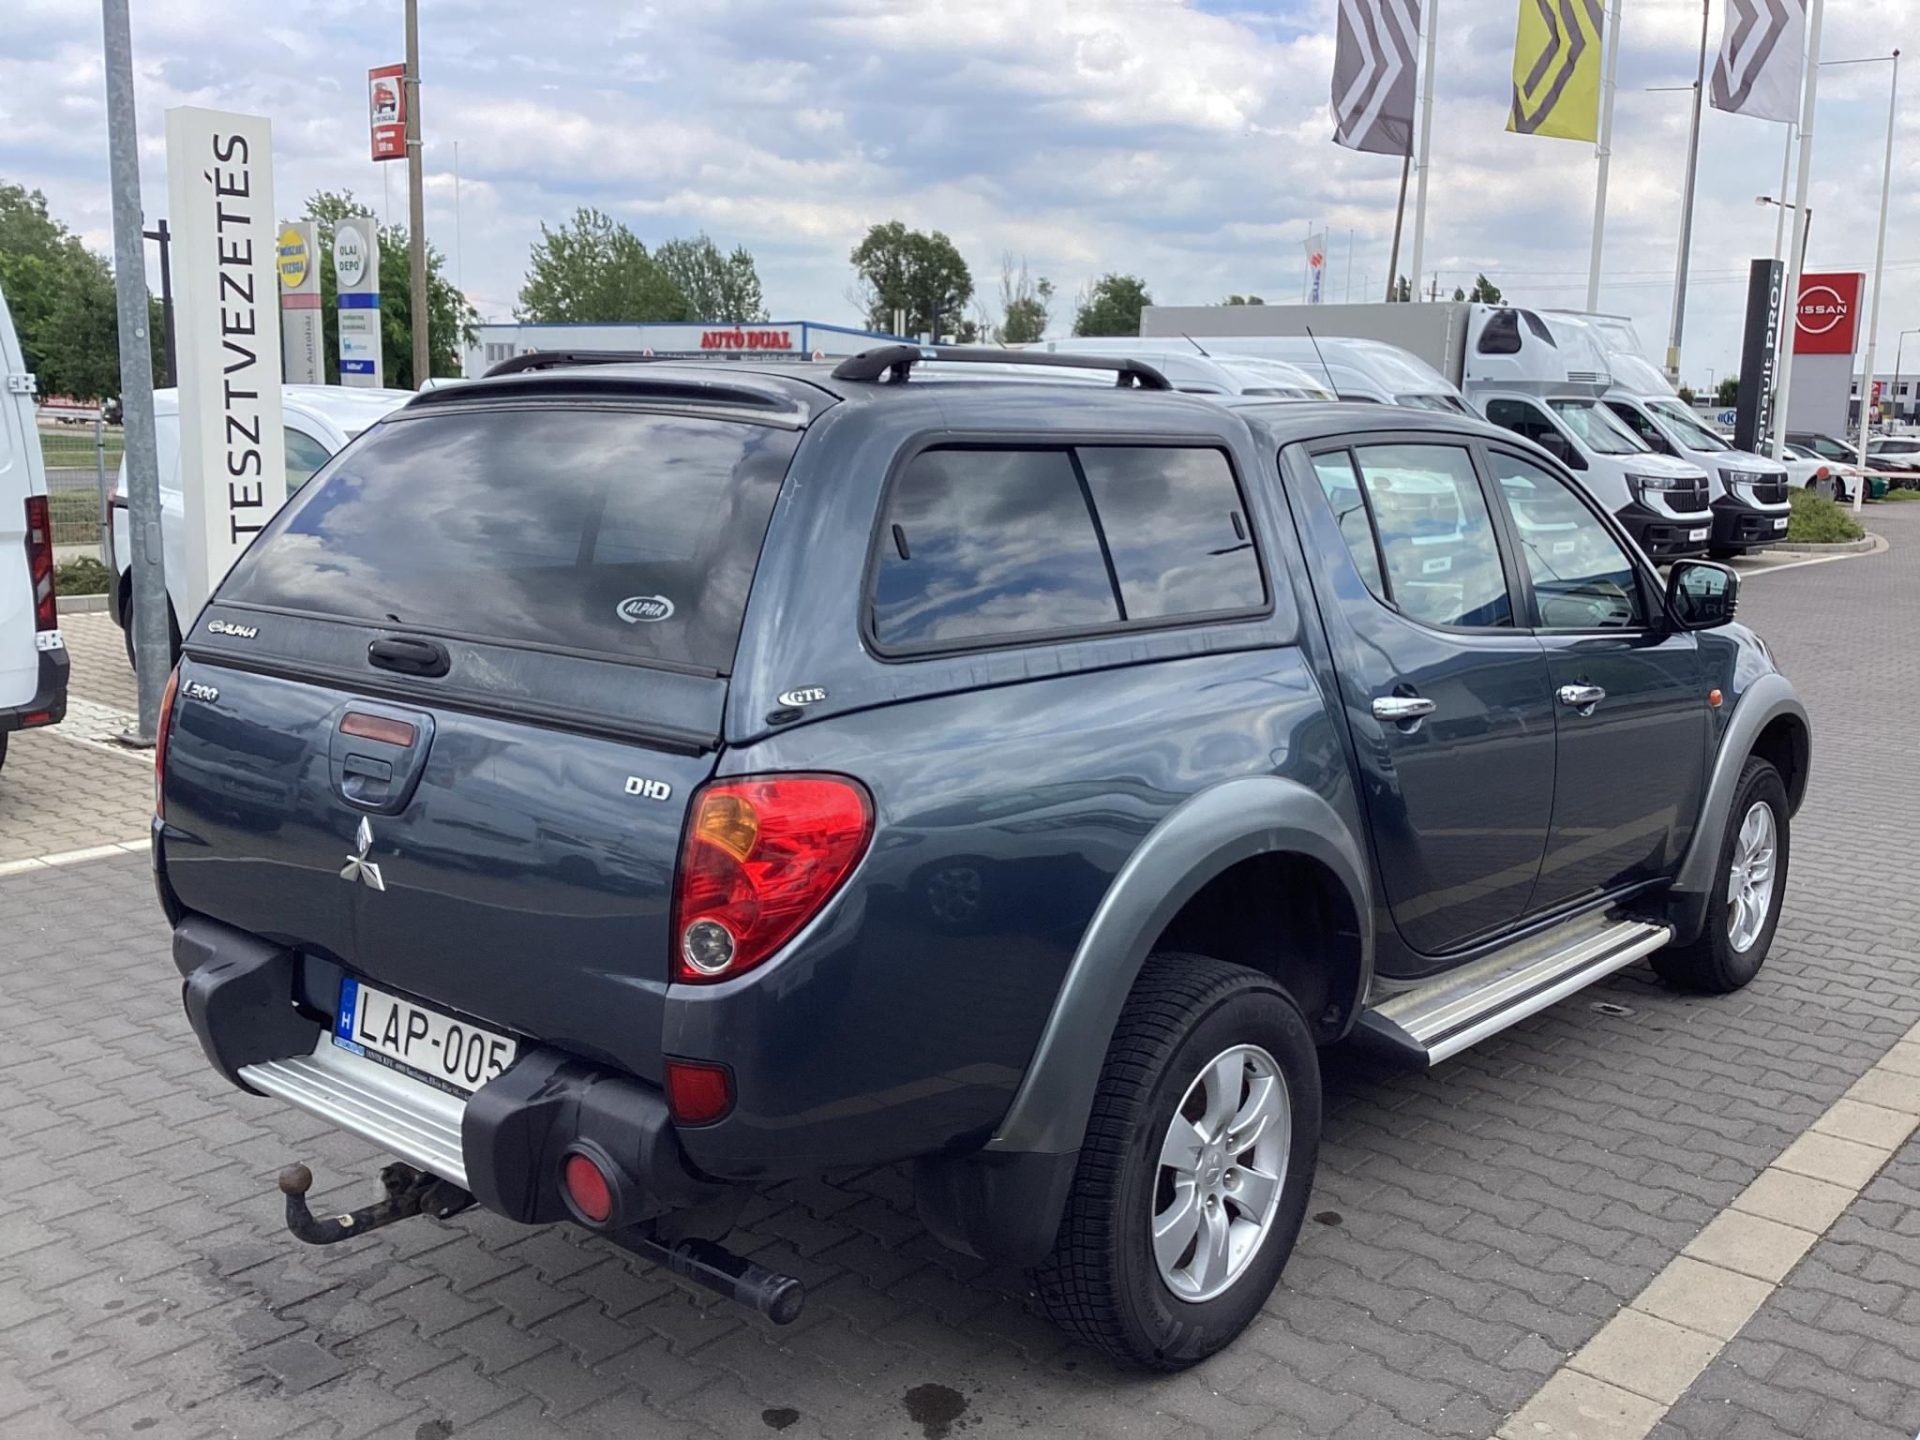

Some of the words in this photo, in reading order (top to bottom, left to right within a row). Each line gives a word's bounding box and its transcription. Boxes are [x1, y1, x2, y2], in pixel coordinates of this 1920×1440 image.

[340, 245, 357, 255] OLAJ
[204, 134, 263, 544] TESZTVEZETÉS
[701, 325, 745, 349] AUTÓ
[747, 331, 792, 349] DUAL
[1754, 358, 1773, 456] Renault
[1766, 269, 1780, 349] PRO+
[625, 601, 666, 616] ALPHA
[790, 687, 827, 702] GTE
[341, 1012, 351, 1029] H
[359, 991, 508, 1083] LAP-005
